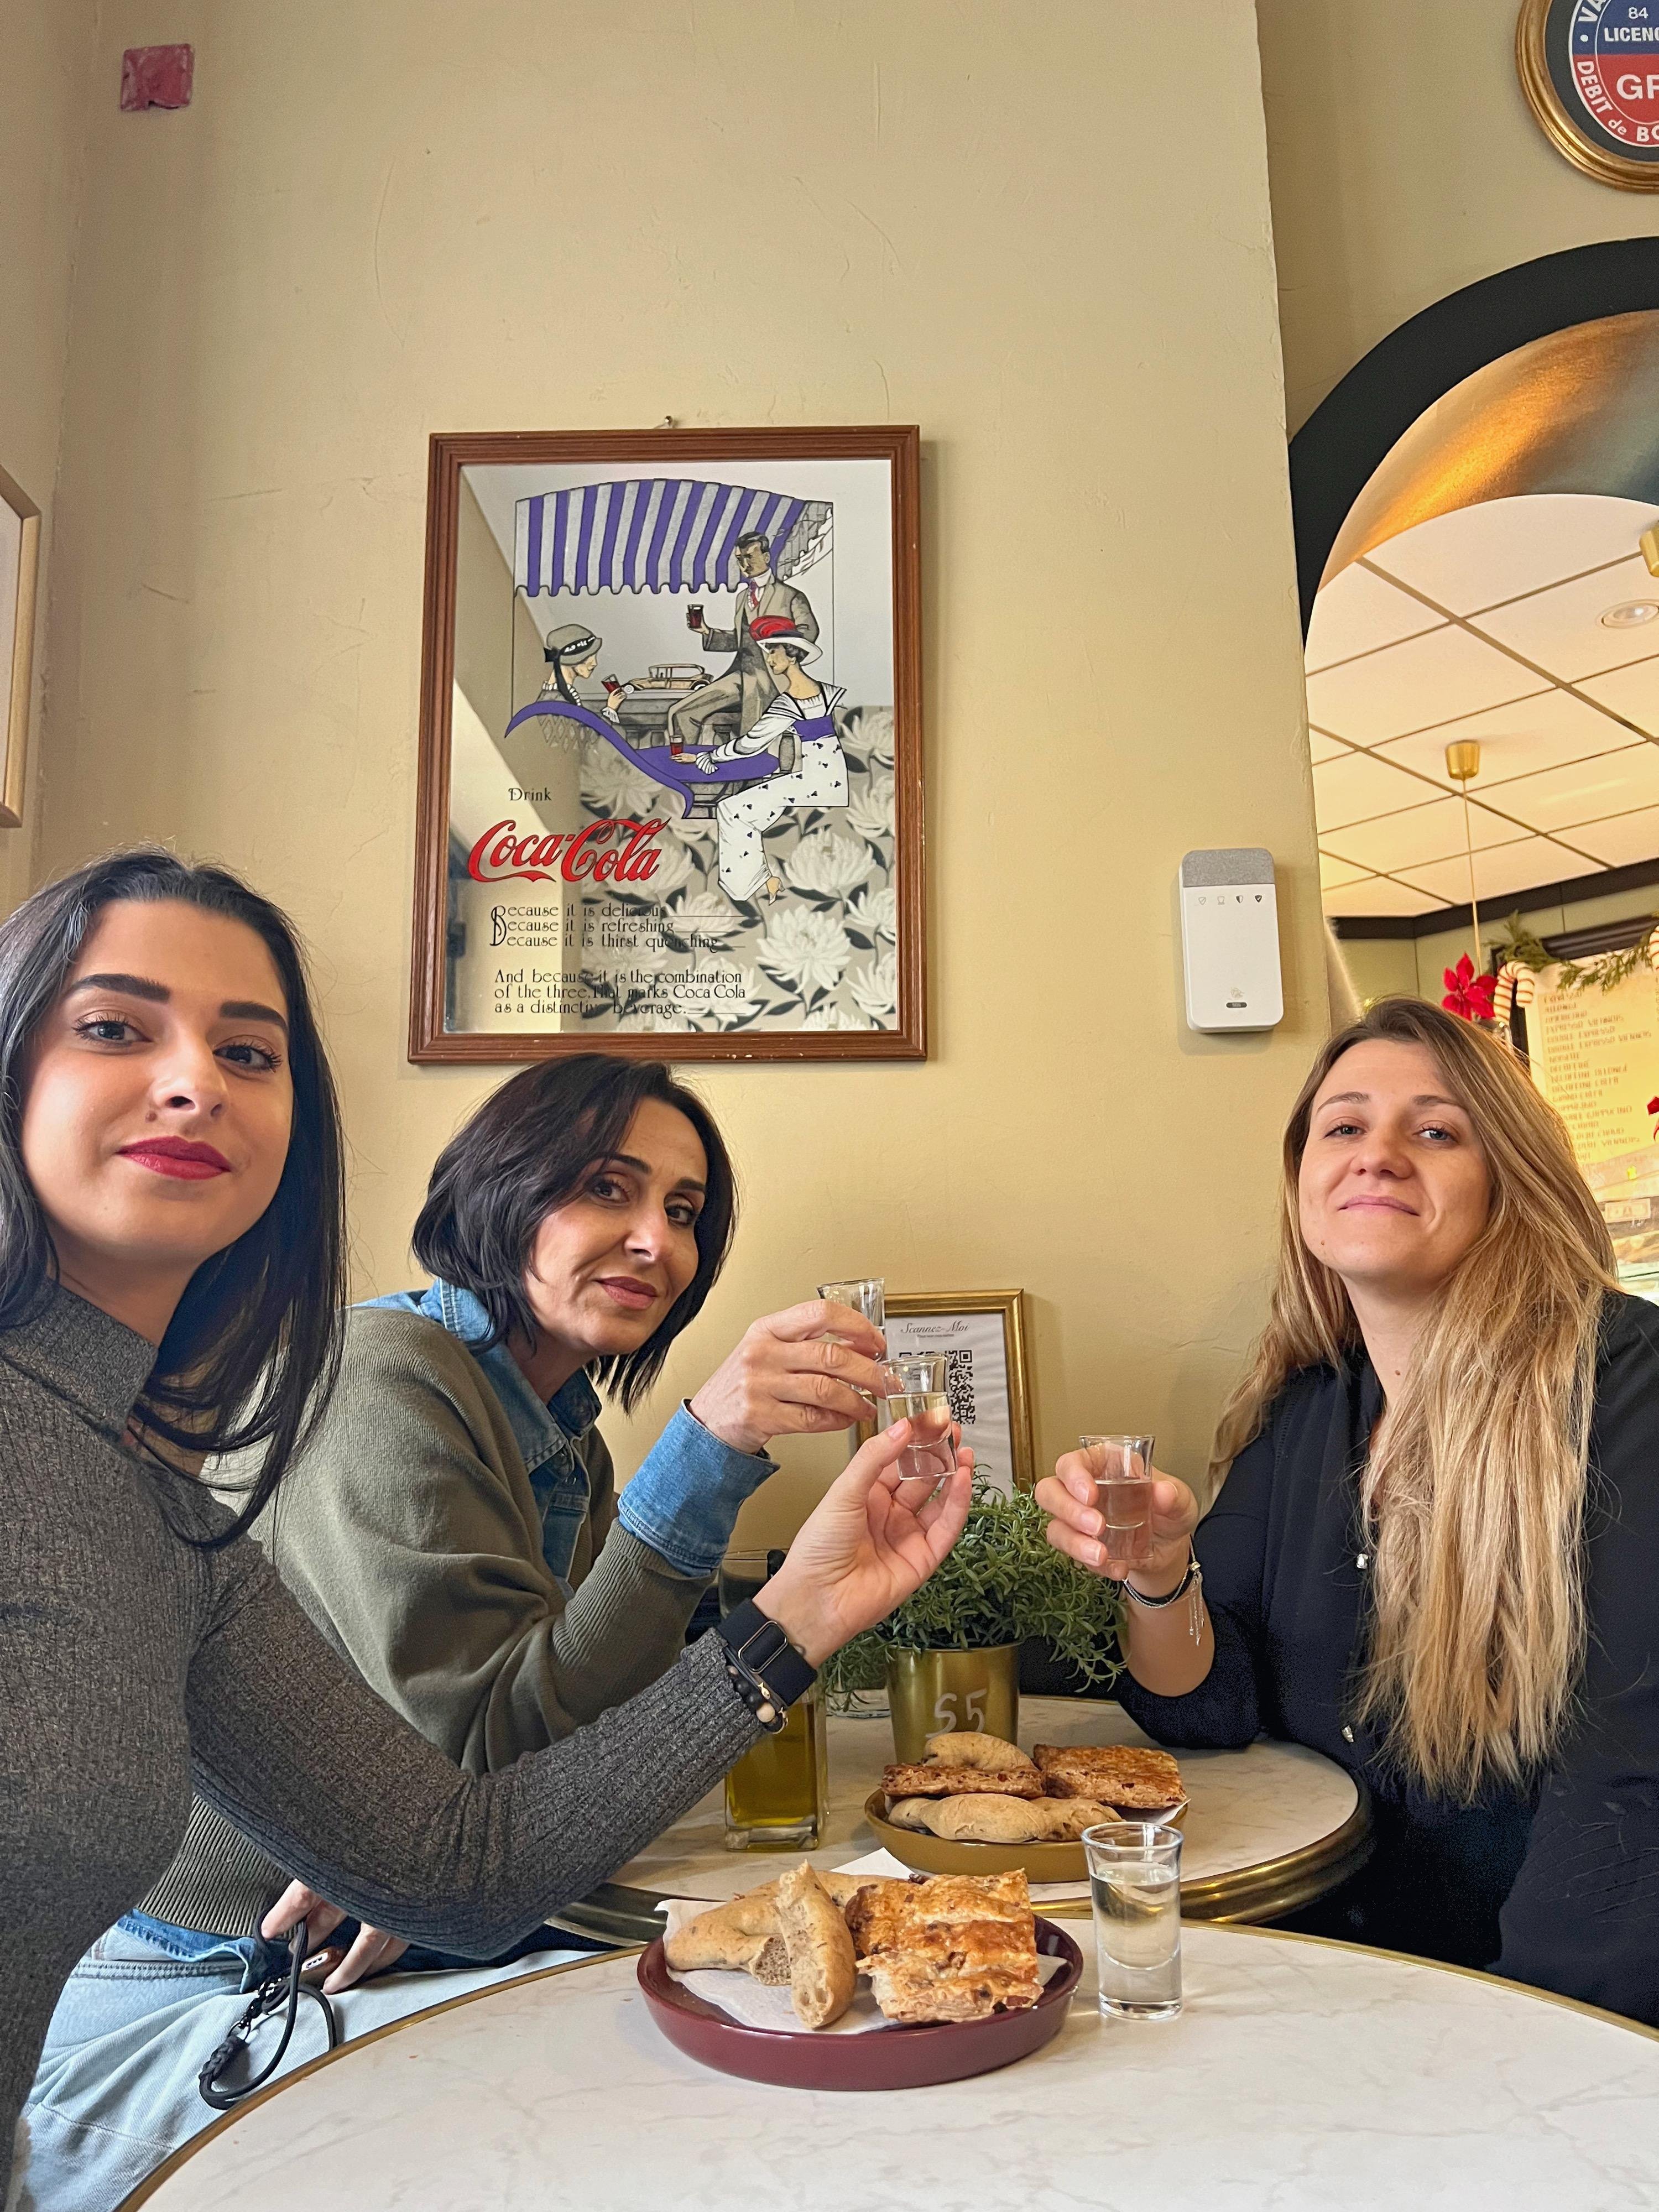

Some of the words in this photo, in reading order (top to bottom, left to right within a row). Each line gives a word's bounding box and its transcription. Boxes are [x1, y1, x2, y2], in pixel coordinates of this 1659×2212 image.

[1628, 7, 1648, 19] 84
[1577, 60, 1614, 113] DEBIT
[1608, 119, 1627, 135] de
[508, 787, 552, 801] Drink
[467, 817, 671, 883] Coca-Cola
[566, 903, 576, 916] it
[583, 904, 595, 916] is
[602, 902, 665, 917] deliciou
[566, 918, 576, 932] it
[583, 918, 595, 932] is
[602, 918, 674, 935] refreshing
[565, 933, 575, 947] it
[582, 933, 594, 947] is
[602, 933, 639, 947] thirst
[646, 933, 718, 953] quenching
[495, 968, 524, 983] And
[533, 968, 594, 983] because
[599, 969, 608, 983] it
[615, 969, 626, 983] is
[630, 969, 653, 983] the
[658, 969, 742, 983] combination
[494, 984, 513, 998] of
[518, 984, 541, 998] the
[628, 984, 668, 998] marks
[674, 984, 710, 999] Coca
[714, 984, 745, 999] Cola
[495, 1003, 512, 1014] as
[517, 1003, 524, 1014] a
[530, 1000, 606, 1014] distinctiv
[900, 1320, 969, 1333] Scannez-Moi
